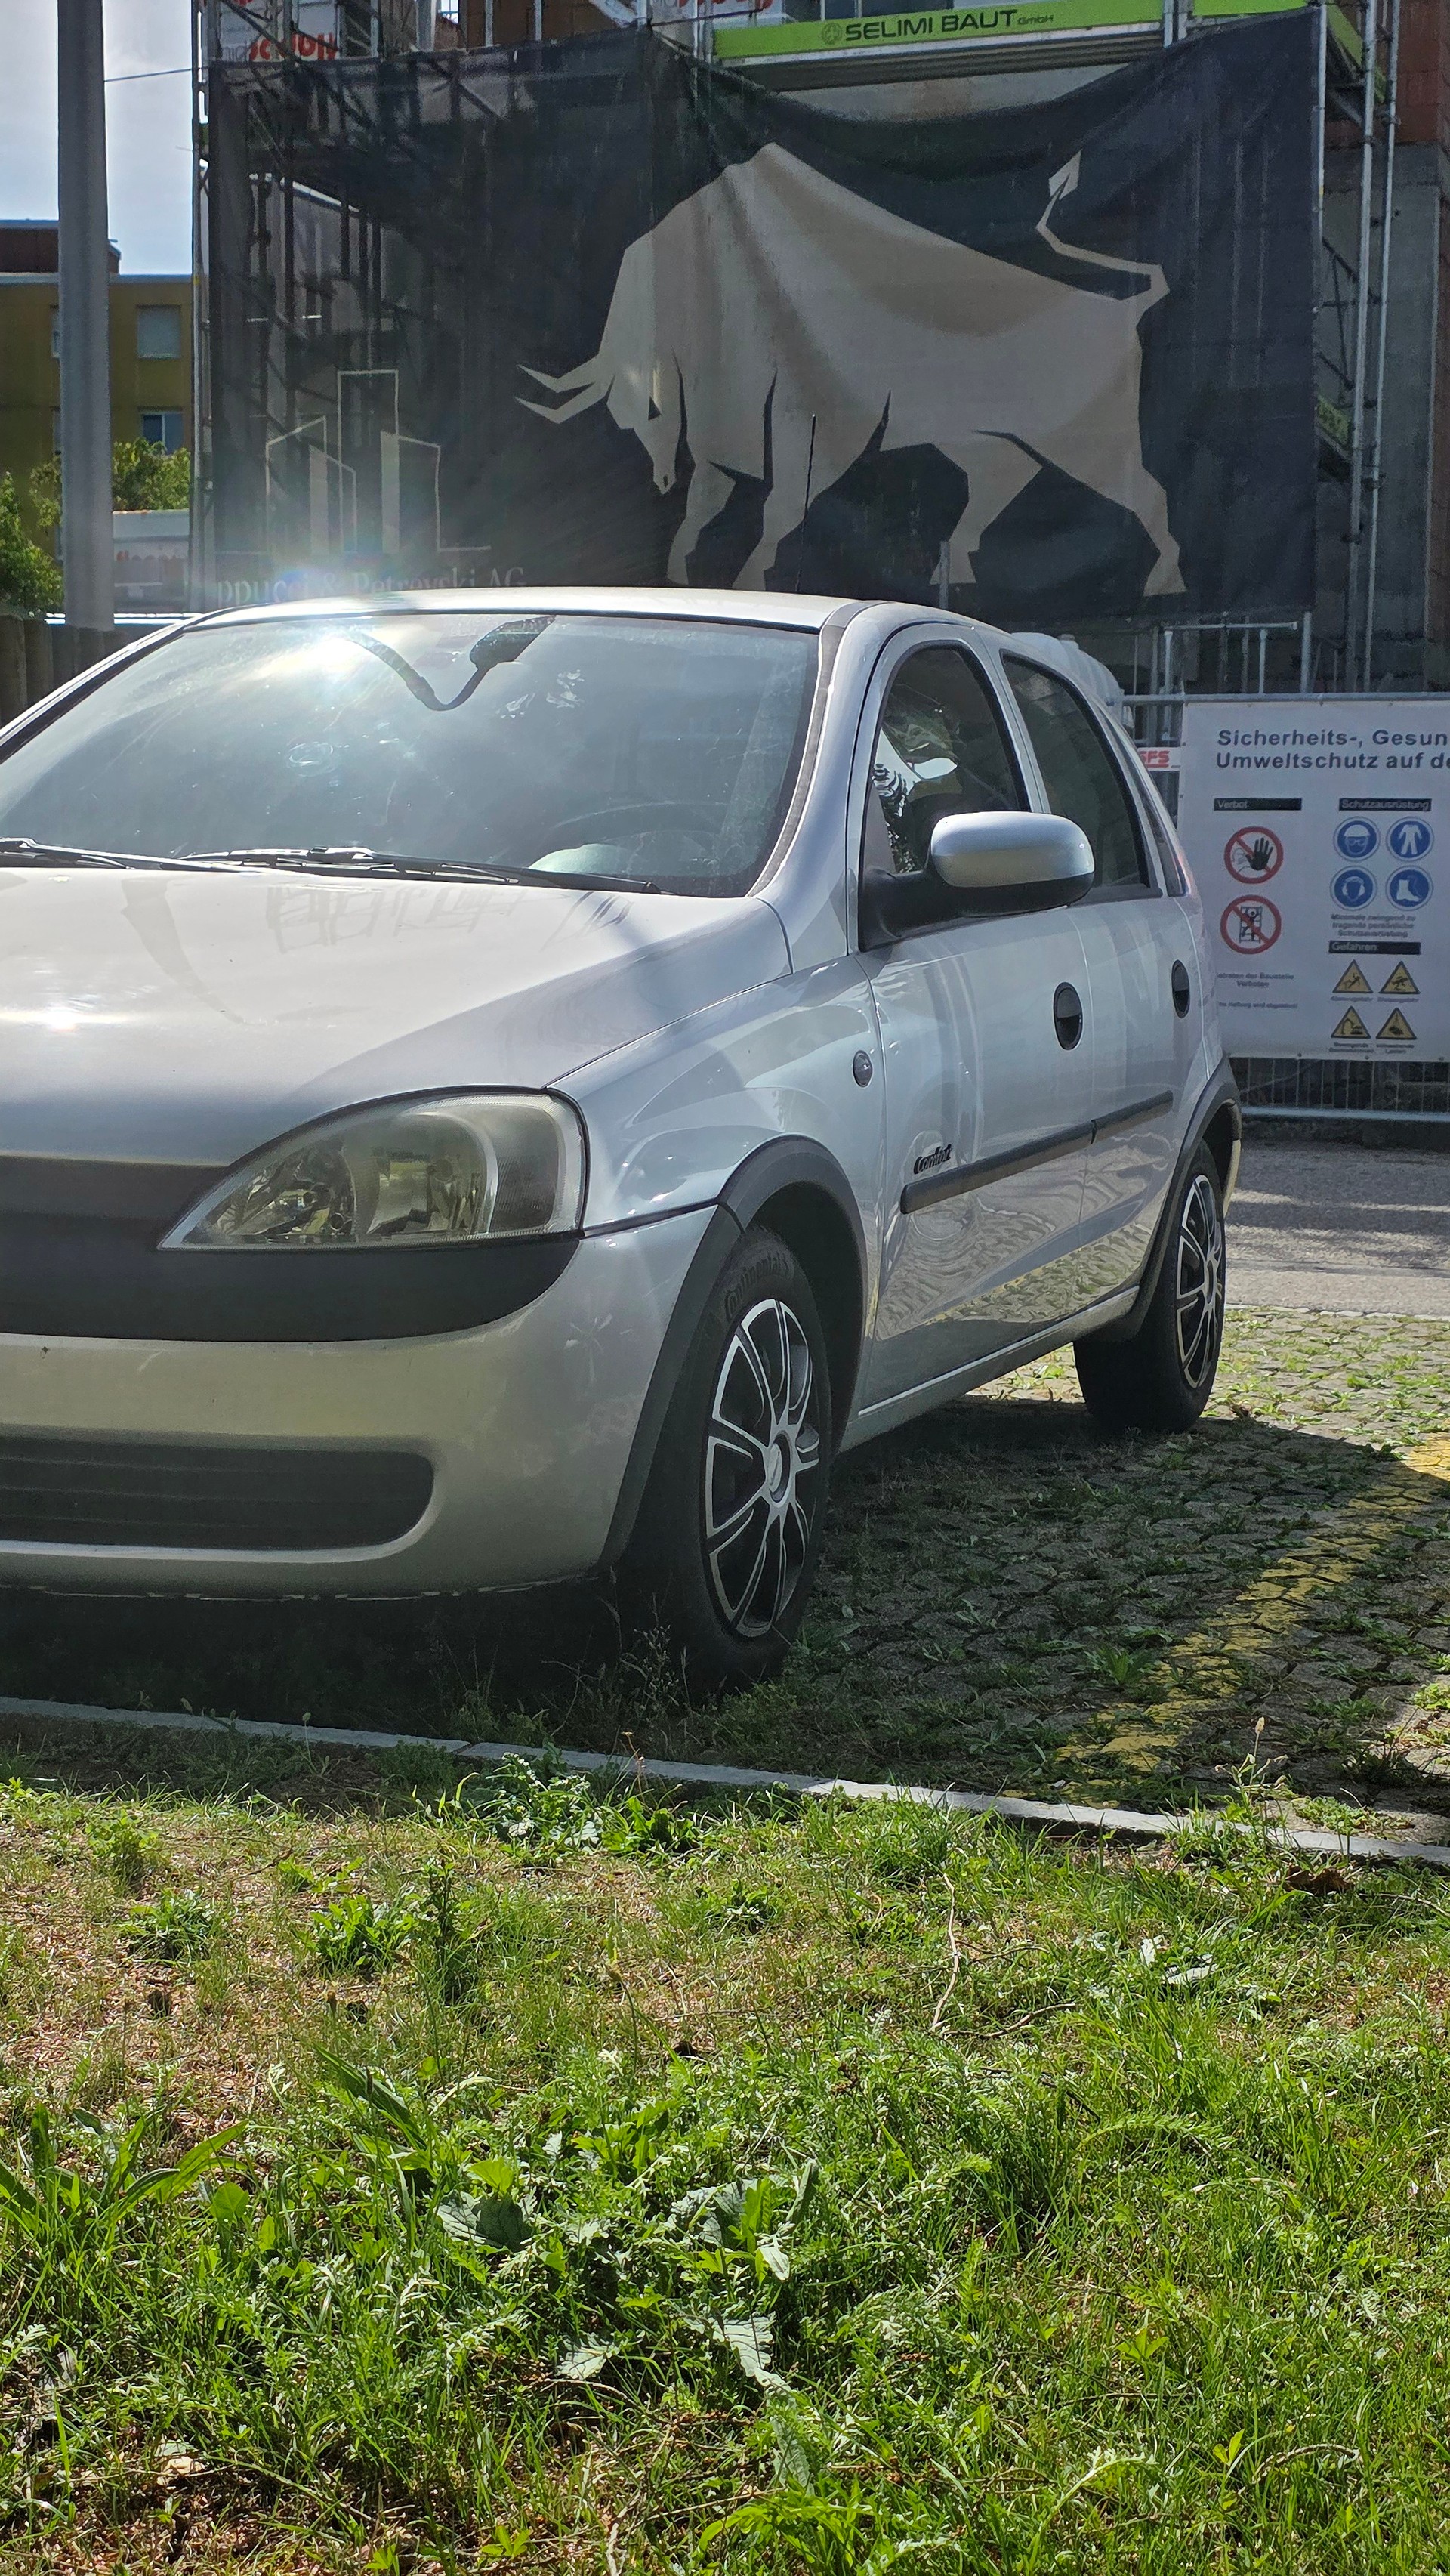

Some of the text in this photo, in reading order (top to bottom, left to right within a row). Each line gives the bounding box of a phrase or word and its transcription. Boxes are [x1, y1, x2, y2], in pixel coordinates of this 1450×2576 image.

[845, 17, 933, 41] SELIMI
[941, 9, 1018, 32] BAUT
[1217, 729, 1448, 749] Sicherheits-, Gesun
[1217, 752, 1378, 769] Umweltschutz
[1386, 752, 1424, 768] auf
